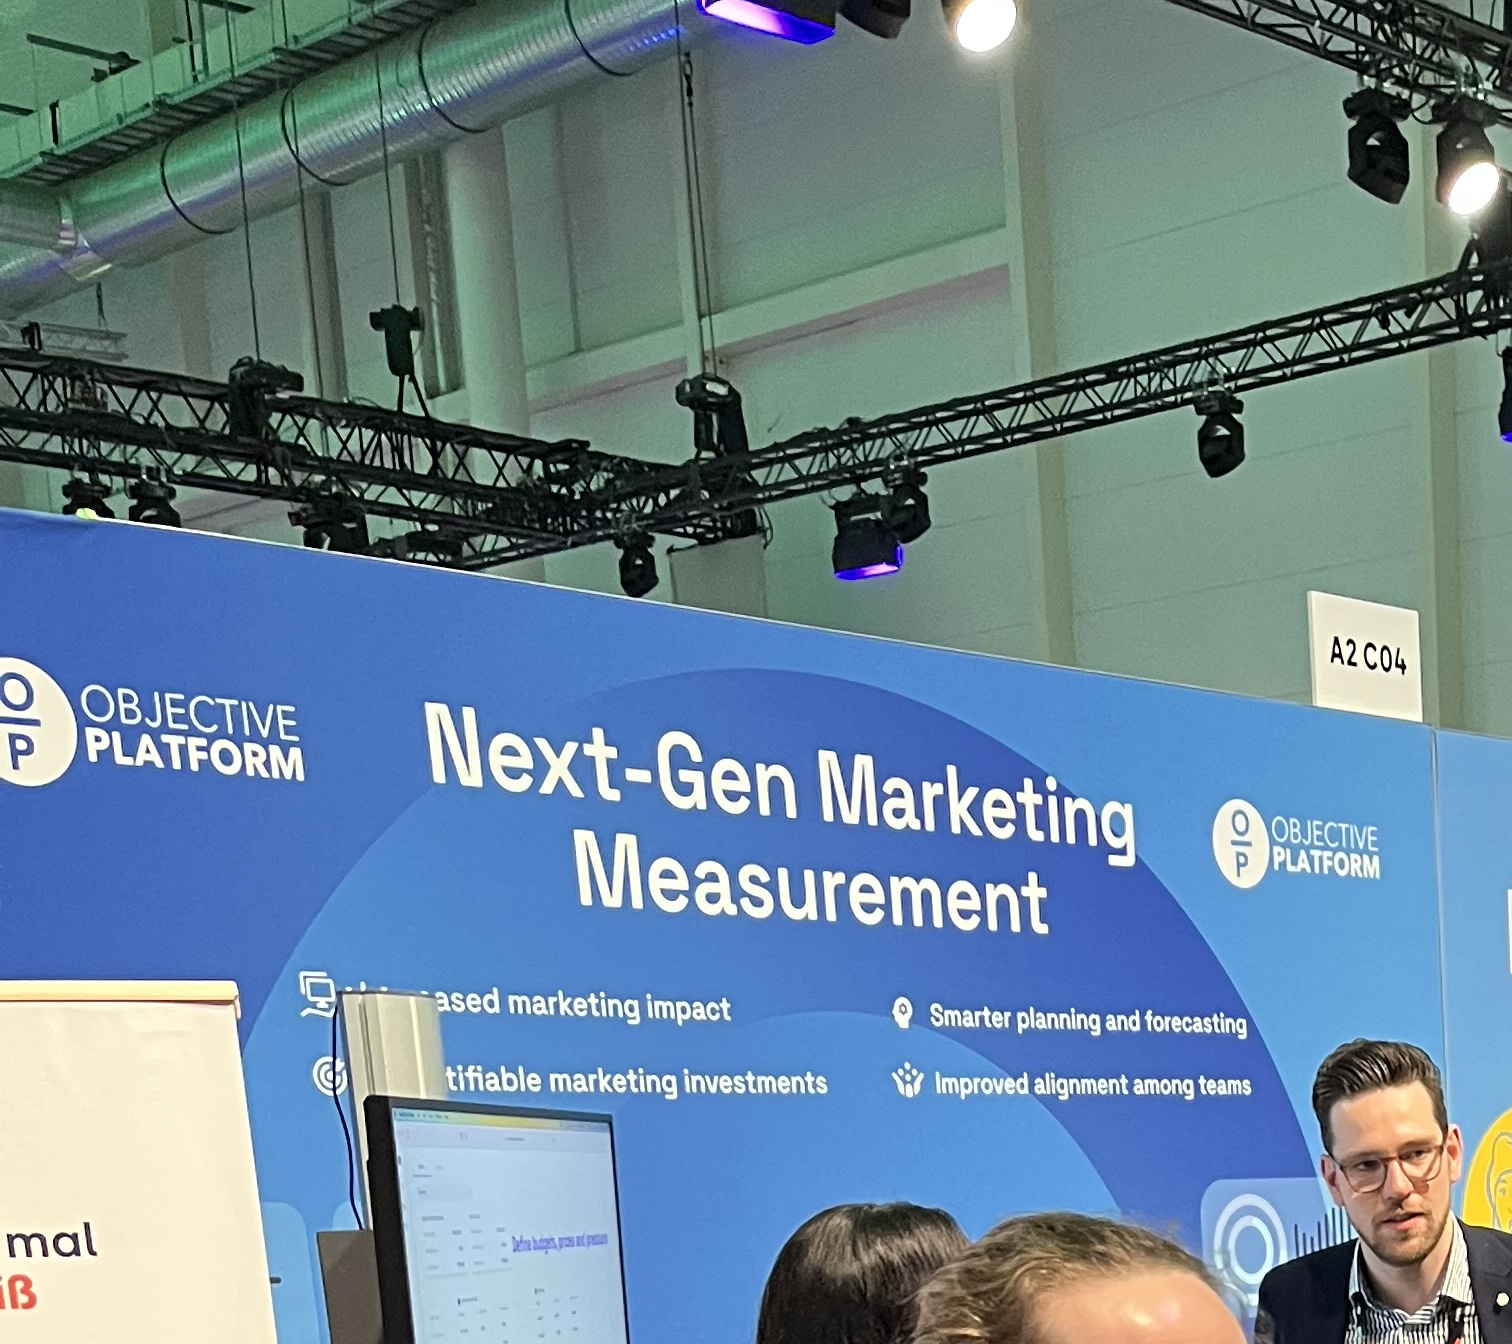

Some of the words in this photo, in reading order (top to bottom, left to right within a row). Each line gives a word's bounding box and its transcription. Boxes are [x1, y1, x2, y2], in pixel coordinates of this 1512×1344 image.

[1329, 635, 1357, 668] A2
[80, 684, 300, 742] OBJECTIVE
[85, 726, 305, 782] PLATFORM
[423, 700, 798, 820] Next-Gen
[818, 748, 1137, 867] Marketing
[1271, 815, 1379, 853] OBJECTIVE
[571, 827, 1050, 936] Measurement
[1273, 845, 1381, 881] PLATFORM
[508, 989, 641, 1025] marketing
[646, 996, 732, 1027] impact
[929, 1002, 1011, 1029] Smarter
[1016, 1007, 1101, 1036] planning
[1105, 1010, 1141, 1032] and
[1144, 1010, 1248, 1039] forecasting
[549, 1067, 679, 1101] marketing
[683, 1069, 828, 1098] investments
[934, 1071, 1029, 1101] Improved
[1033, 1072, 1129, 1101] alignment
[1133, 1078, 1195, 1101] among
[1198, 1074, 1252, 1096] teams
[6, 1221, 98, 1258] mal
